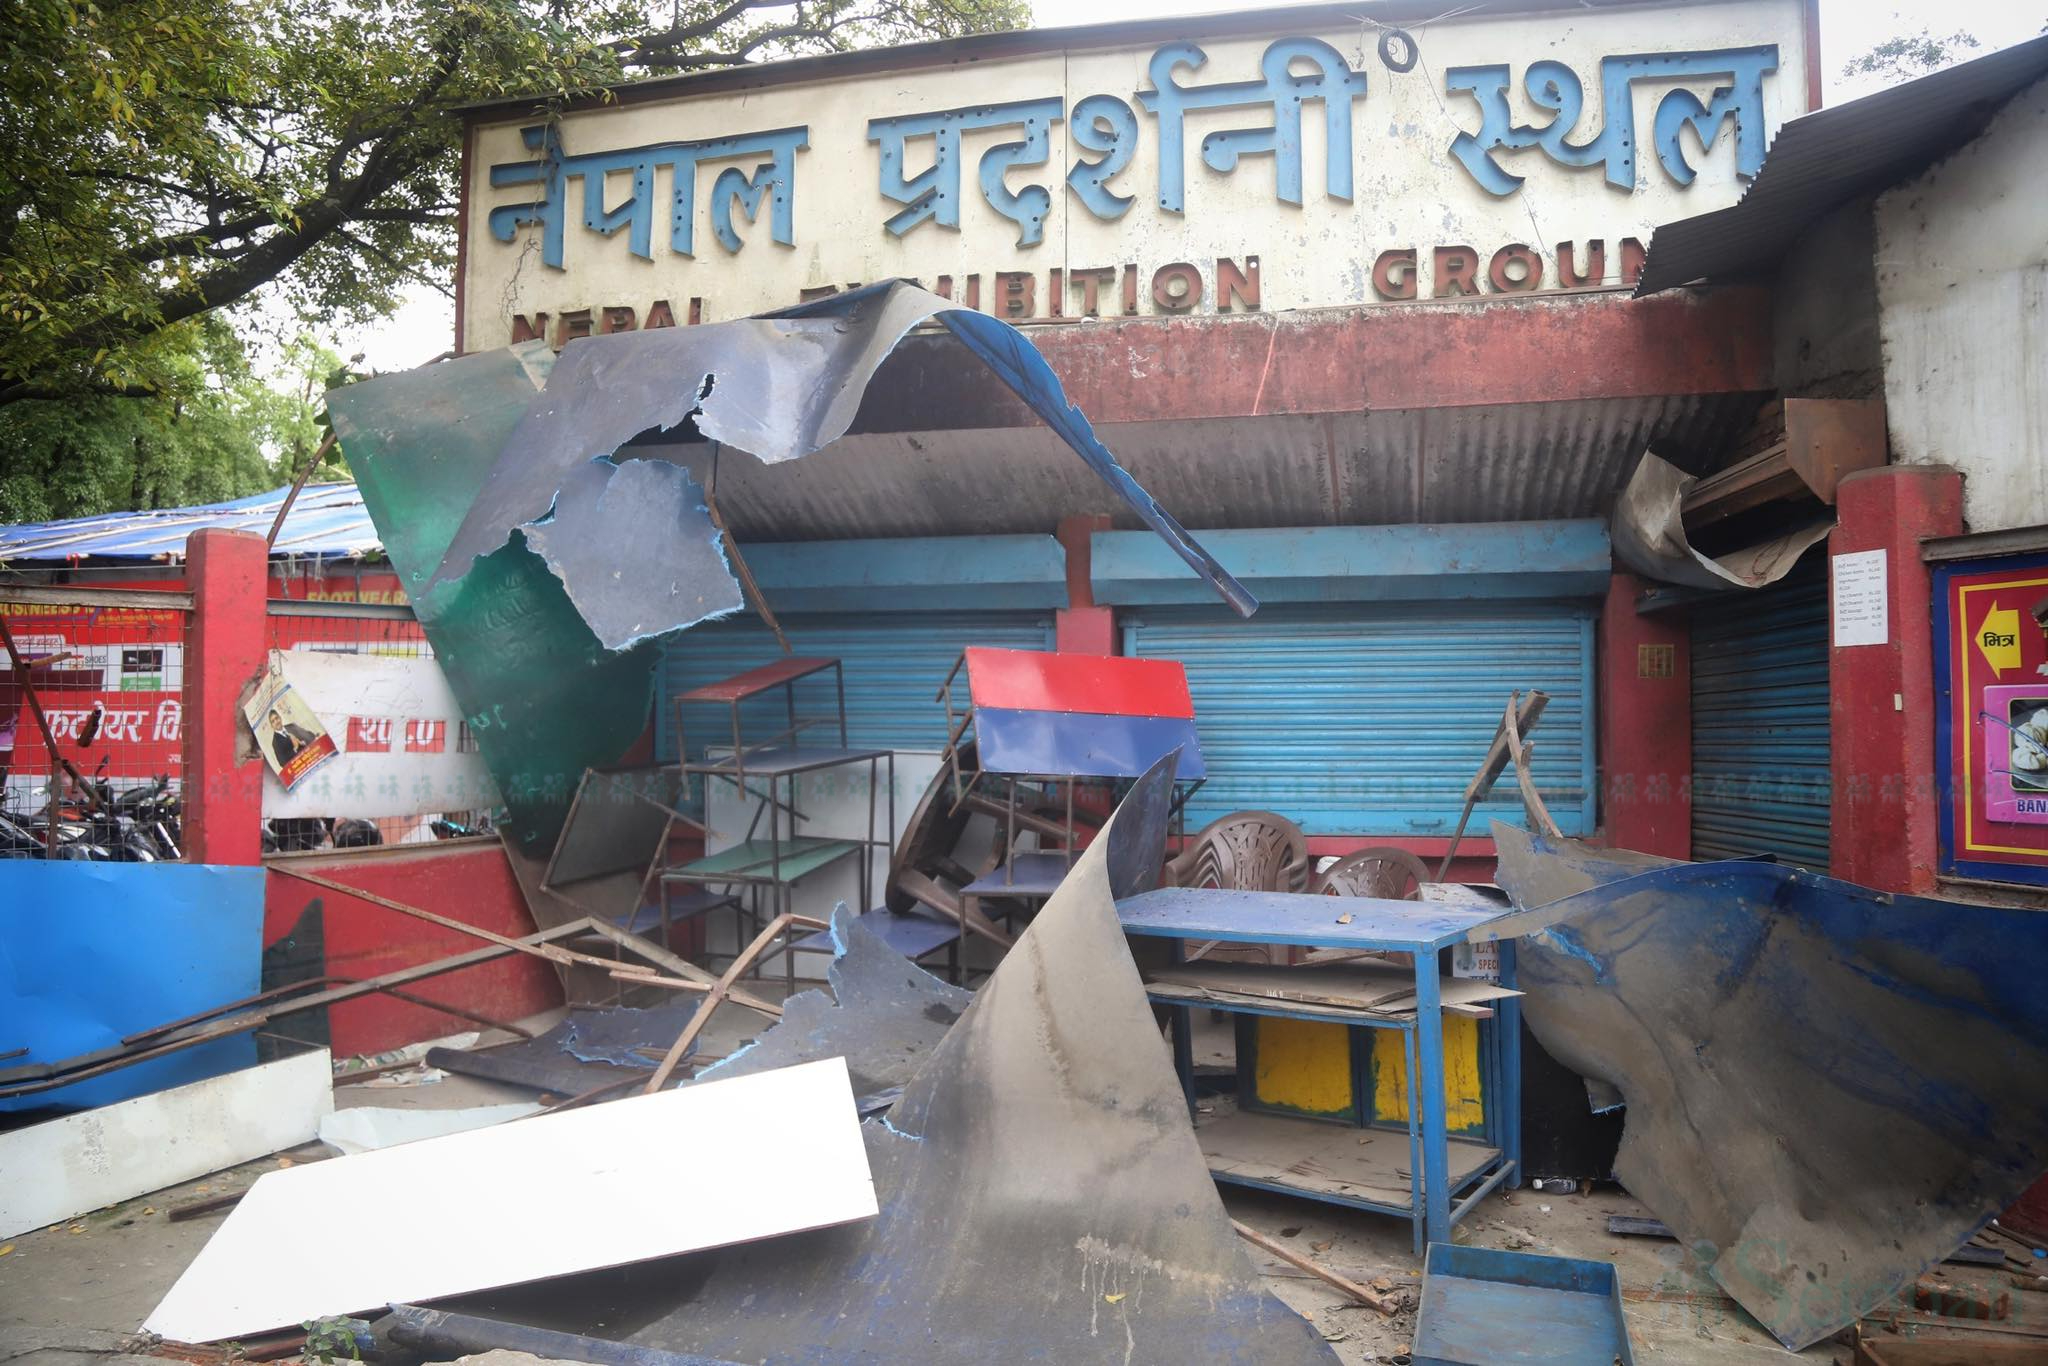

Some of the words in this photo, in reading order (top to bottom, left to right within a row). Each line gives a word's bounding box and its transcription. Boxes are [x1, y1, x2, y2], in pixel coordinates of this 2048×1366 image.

[489, 124, 809, 272] नेपाल
[868, 36, 1367, 250] प्रदर्शनी
[1445, 44, 1779, 195] स्थल
[1983, 631, 2015, 648] भित्र
[2017, 799, 2048, 813] BAN
